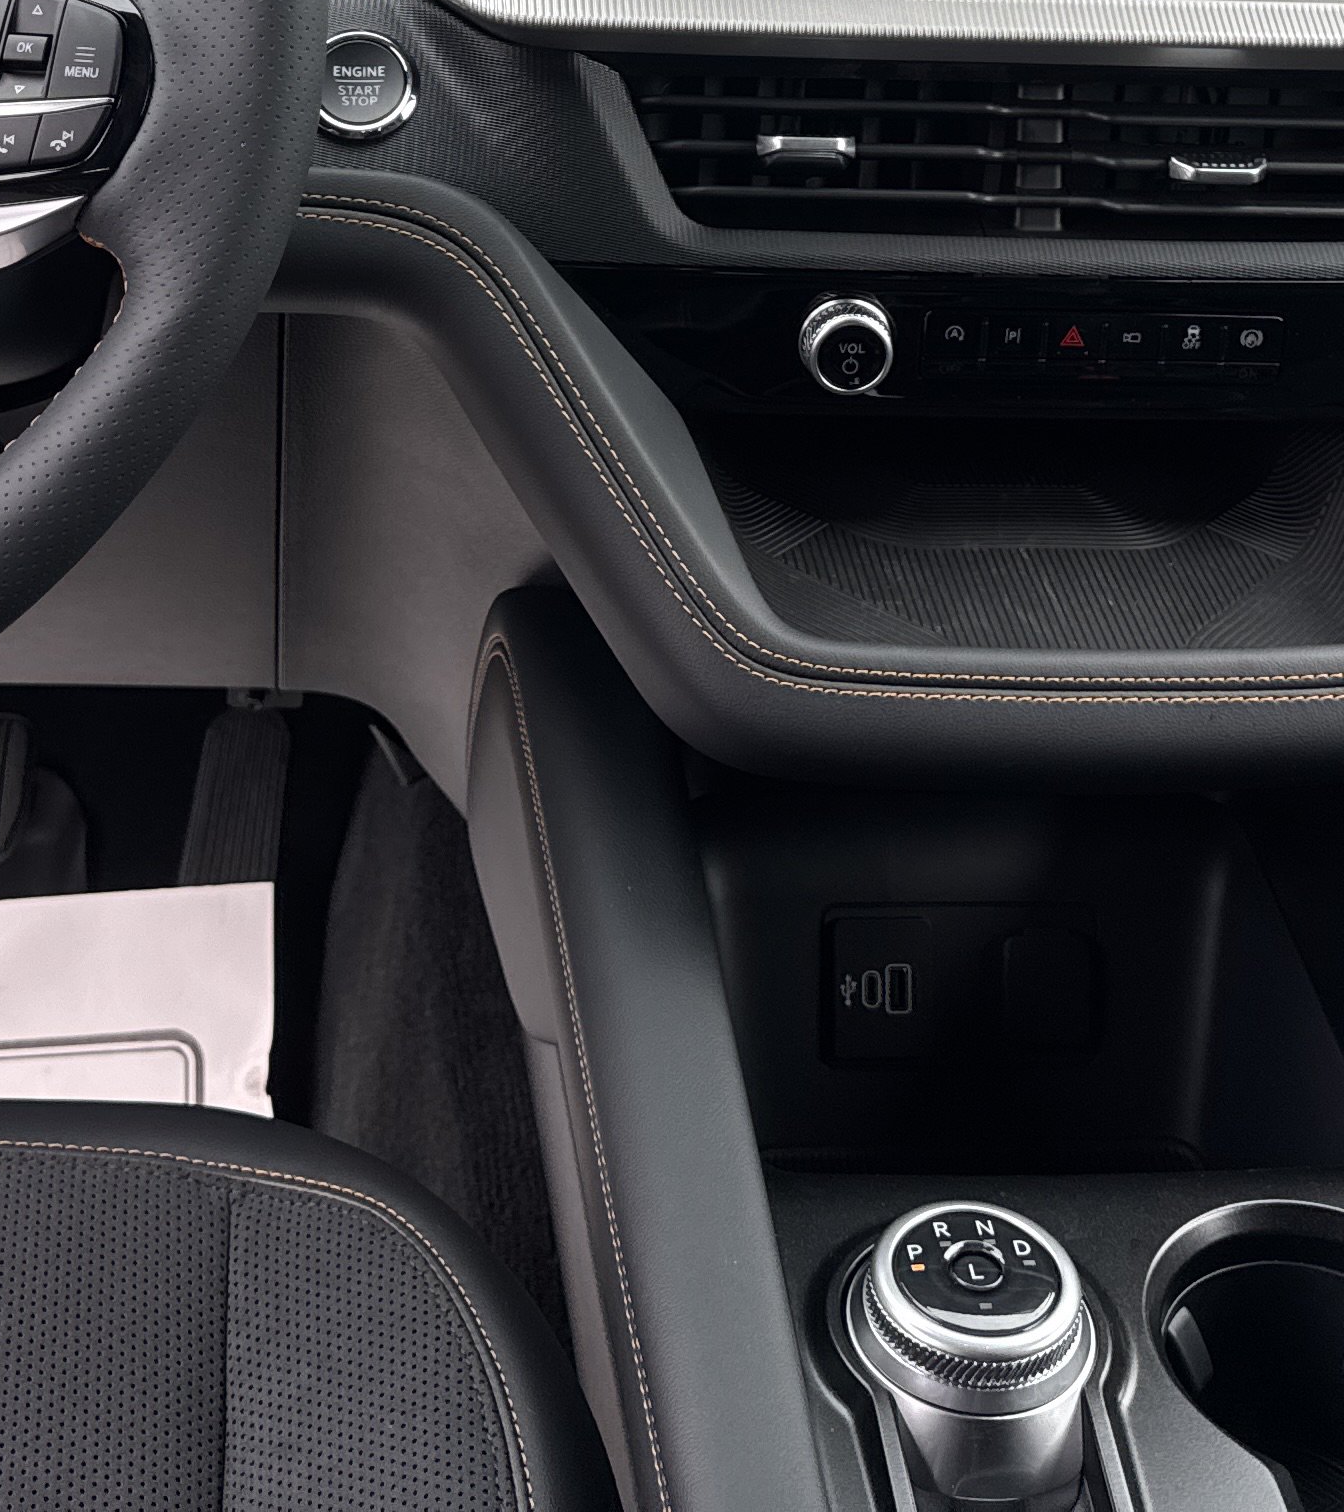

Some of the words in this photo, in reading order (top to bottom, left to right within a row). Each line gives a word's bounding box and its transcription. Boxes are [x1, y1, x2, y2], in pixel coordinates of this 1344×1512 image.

[16, 41, 35, 54] OK
[64, 65, 99, 79] MENU
[332, 65, 386, 78] ENGINE
[337, 85, 382, 96] START
[341, 95, 379, 107] STOP
[838, 343, 866, 354] VOL
[906, 1244, 923, 1261] P
[932, 1221, 952, 1238] R
[974, 1219, 996, 1236] N
[1012, 1239, 1032, 1257] D
[968, 1263, 985, 1280] L
